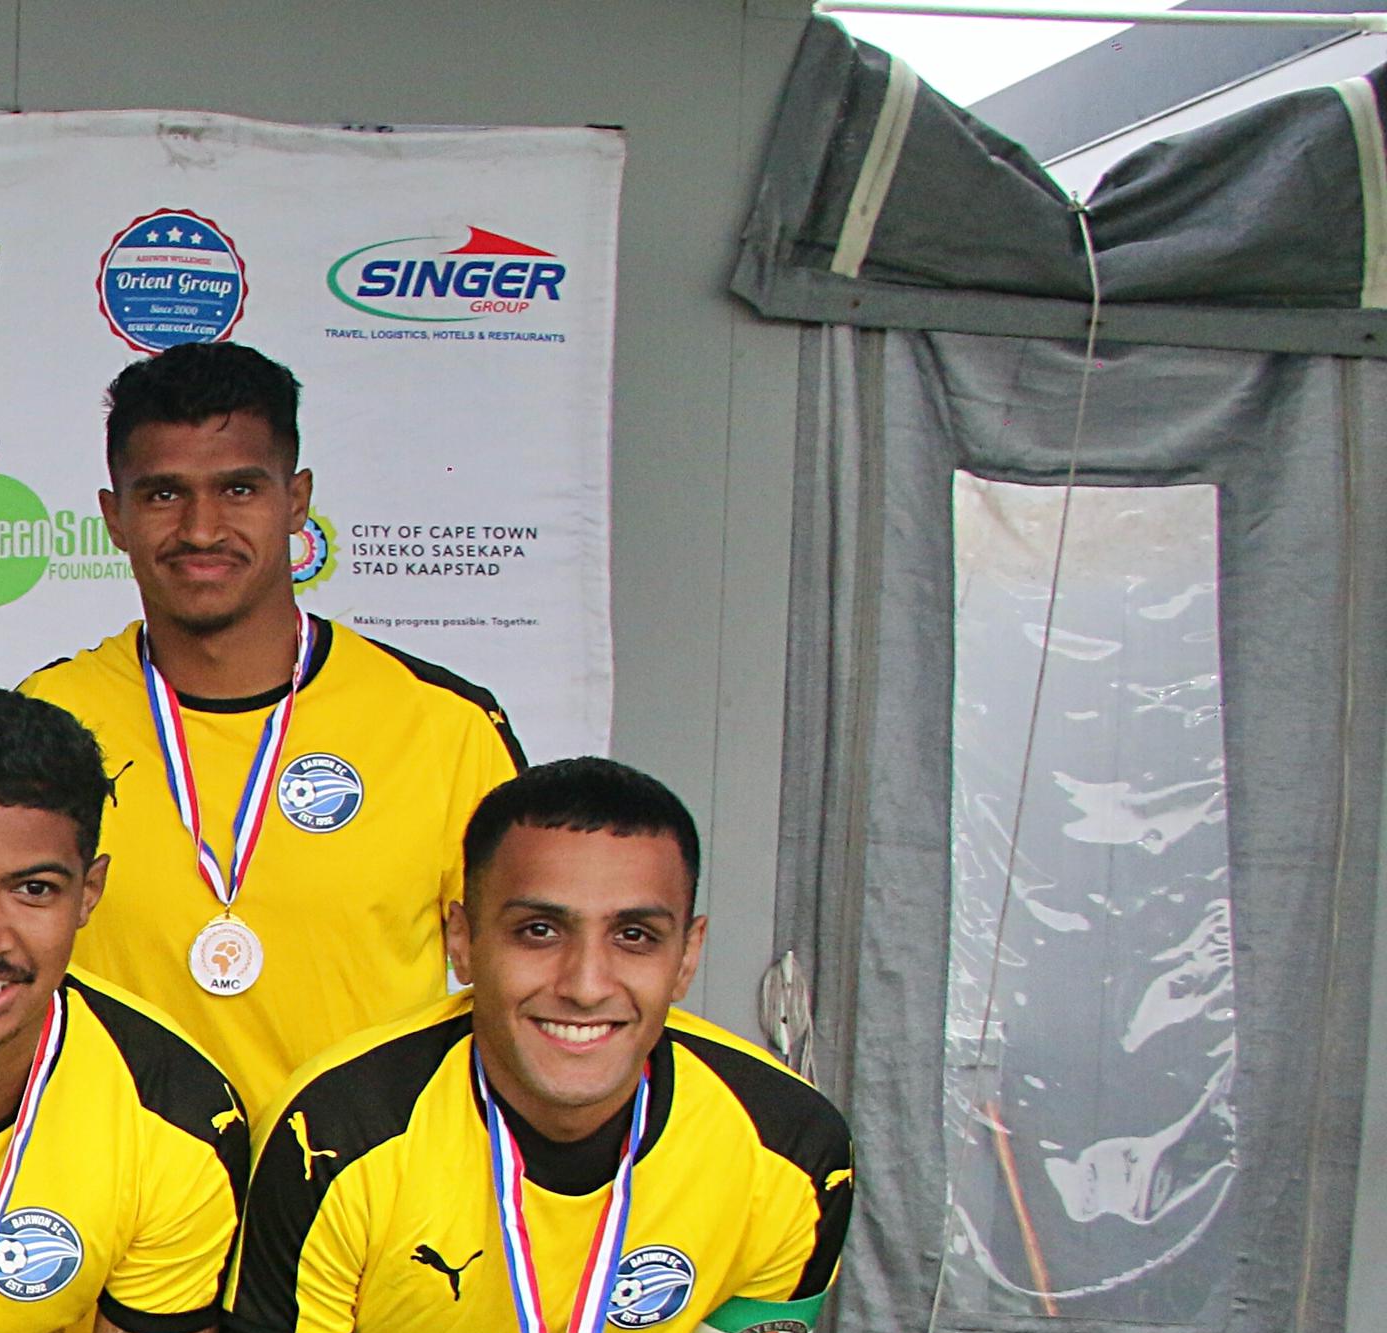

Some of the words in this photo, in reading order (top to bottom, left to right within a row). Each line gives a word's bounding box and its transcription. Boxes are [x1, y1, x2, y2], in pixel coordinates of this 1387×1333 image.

[116, 272, 174, 290] Orient
[178, 272, 232, 298] Group
[357, 260, 566, 300] SINGER
[470, 301, 529, 313] GROUP
[325, 328, 367, 339] TRAVEL,
[371, 330, 430, 340] LOGISTICS,
[433, 330, 475, 340] HOTELS
[477, 331, 485, 340] &
[488, 331, 566, 343] RESTAURANTS
[352, 525, 391, 538] CITY
[398, 526, 422, 539] OF
[429, 526, 475, 539] CAPE
[483, 526, 538, 540] TOWN
[352, 543, 424, 557] ISIXEKO
[431, 544, 525, 558] SASEKAPA
[48, 563, 136, 580] FOUNDATIO
[352, 561, 398, 575] STAD
[405, 563, 500, 577] KAAPSTAD
[353, 616, 392, 627] Making
[395, 617, 439, 627] progress
[443, 616, 489, 627] possible.
[491, 616, 540, 627] Together.
[210, 979, 241, 990] AMC
[11, 1214, 52, 1229] BARWON
[5, 1279, 24, 1294] EST.
